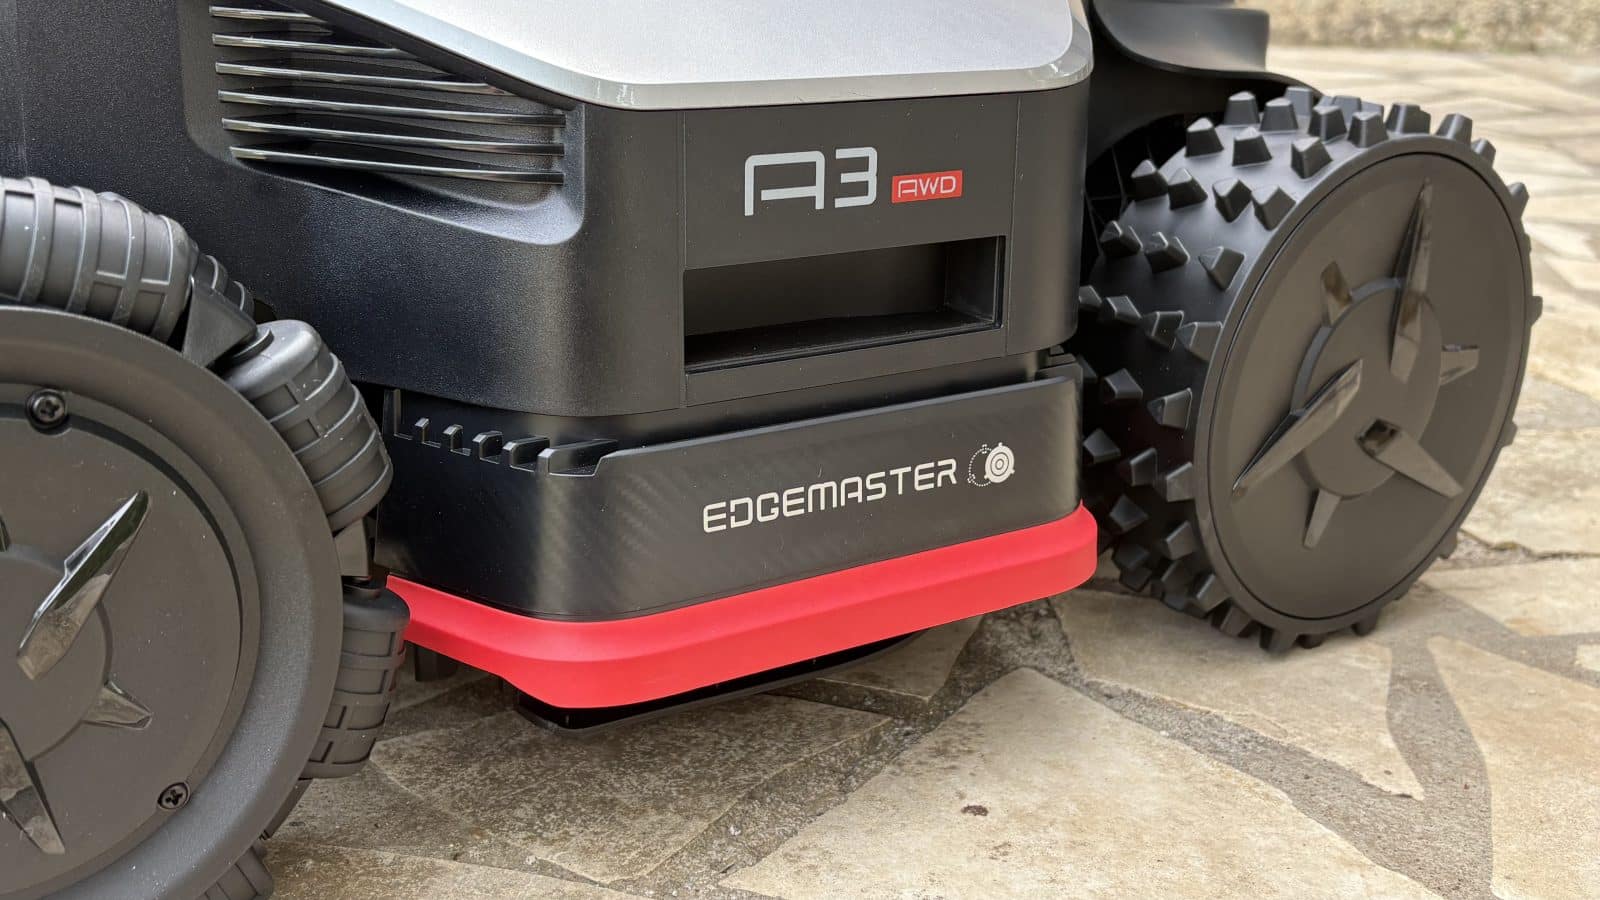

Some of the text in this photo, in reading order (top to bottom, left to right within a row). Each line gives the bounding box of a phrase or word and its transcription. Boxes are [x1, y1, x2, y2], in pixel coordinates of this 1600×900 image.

[744, 146, 957, 216] A3 AWD
[702, 458, 958, 533] EDGEMASTER
